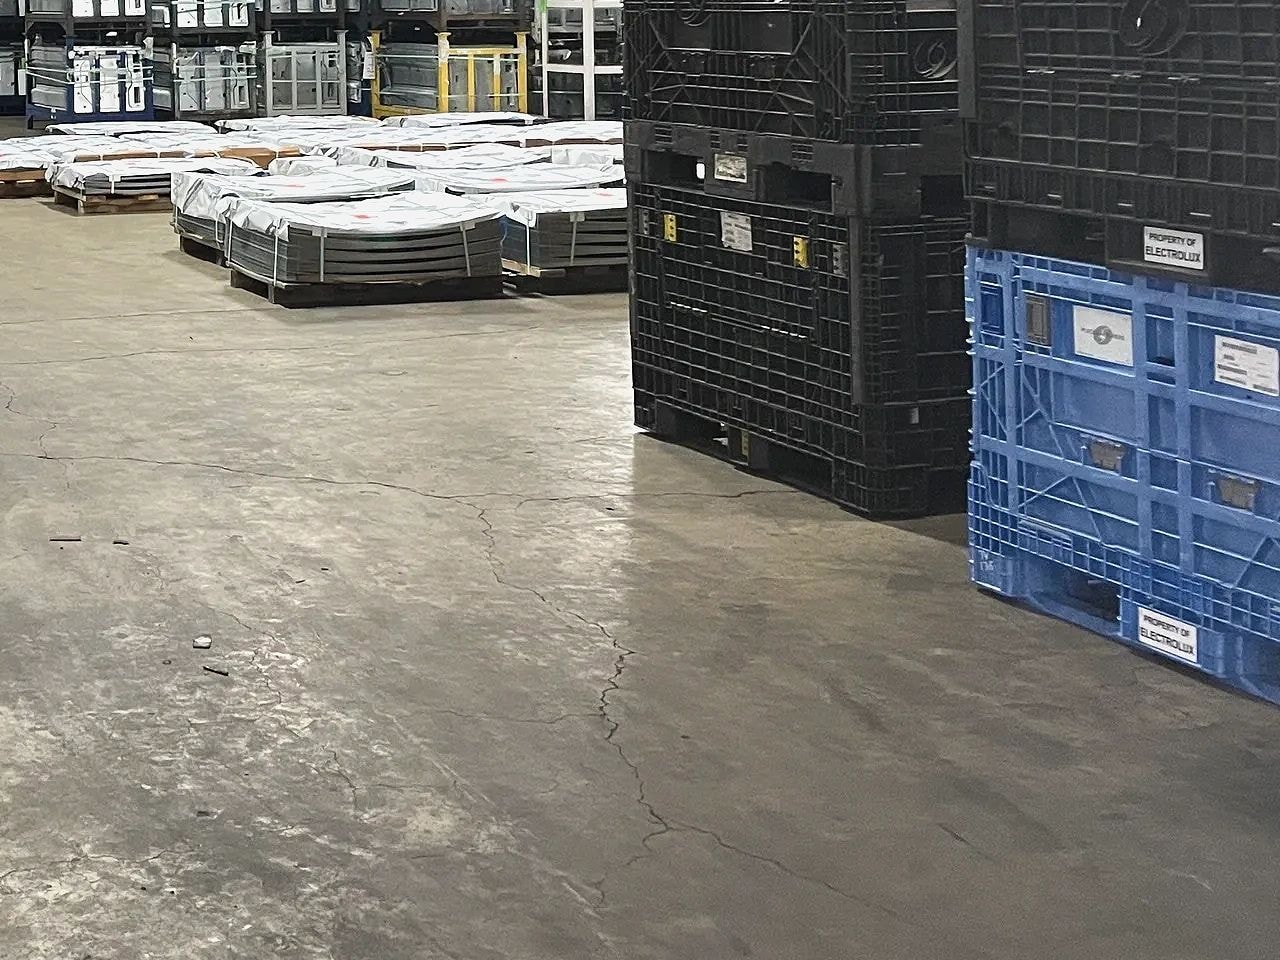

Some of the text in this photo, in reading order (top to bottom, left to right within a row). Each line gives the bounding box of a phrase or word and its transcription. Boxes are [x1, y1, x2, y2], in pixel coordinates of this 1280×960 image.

[1148, 232, 1197, 247] PROPERTY OF
[1145, 245, 1201, 263] ELECTROLUX
[1143, 614, 1190, 637] PROPERTY OF
[1140, 626, 1195, 655] ELECTROLUX
